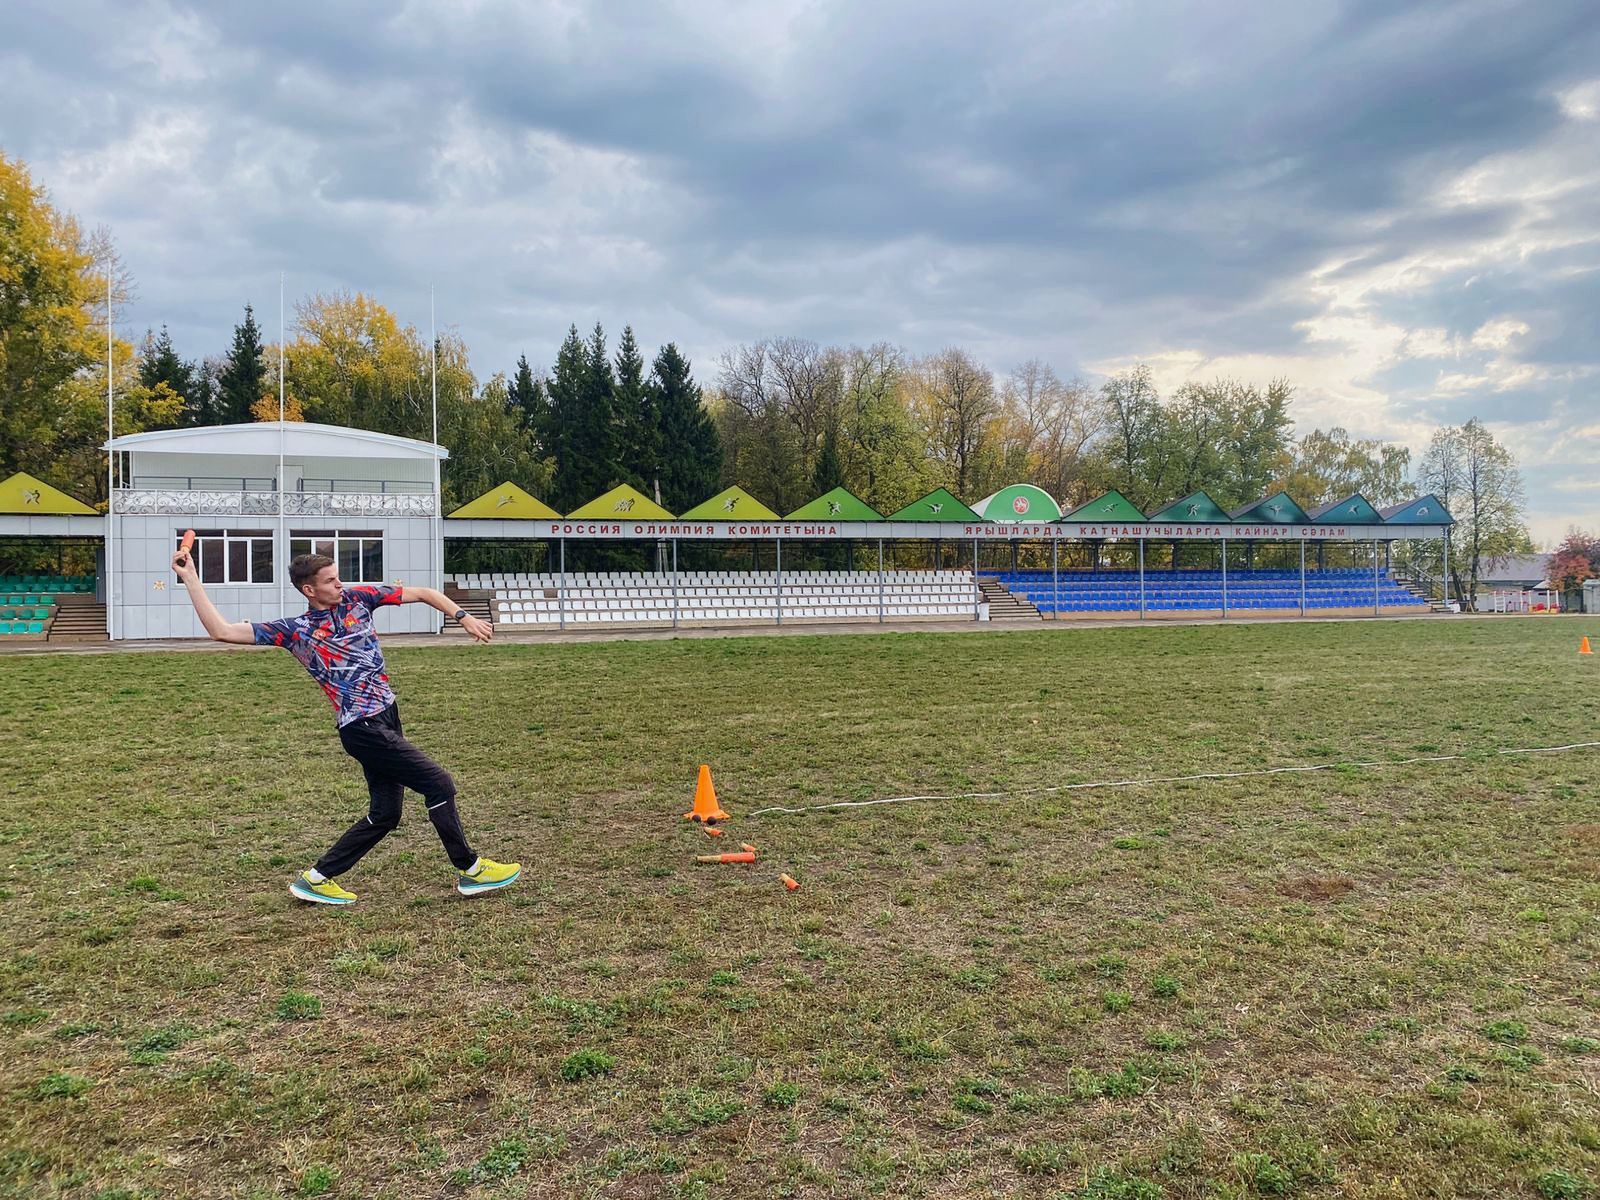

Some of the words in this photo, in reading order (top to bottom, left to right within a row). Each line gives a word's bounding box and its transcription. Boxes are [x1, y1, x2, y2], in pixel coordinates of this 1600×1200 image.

[551, 525, 621, 534] РОССИЯ
[634, 525, 715, 535] ОЛИМПИЯ
[728, 526, 837, 535] КОМИТЕТЫНА
[965, 527, 1063, 536] ЯРЫШЛАРДА
[1080, 527, 1220, 536] КАТНАШУЧЫЛАРГА
[1235, 526, 1288, 536] КАЙНАР
